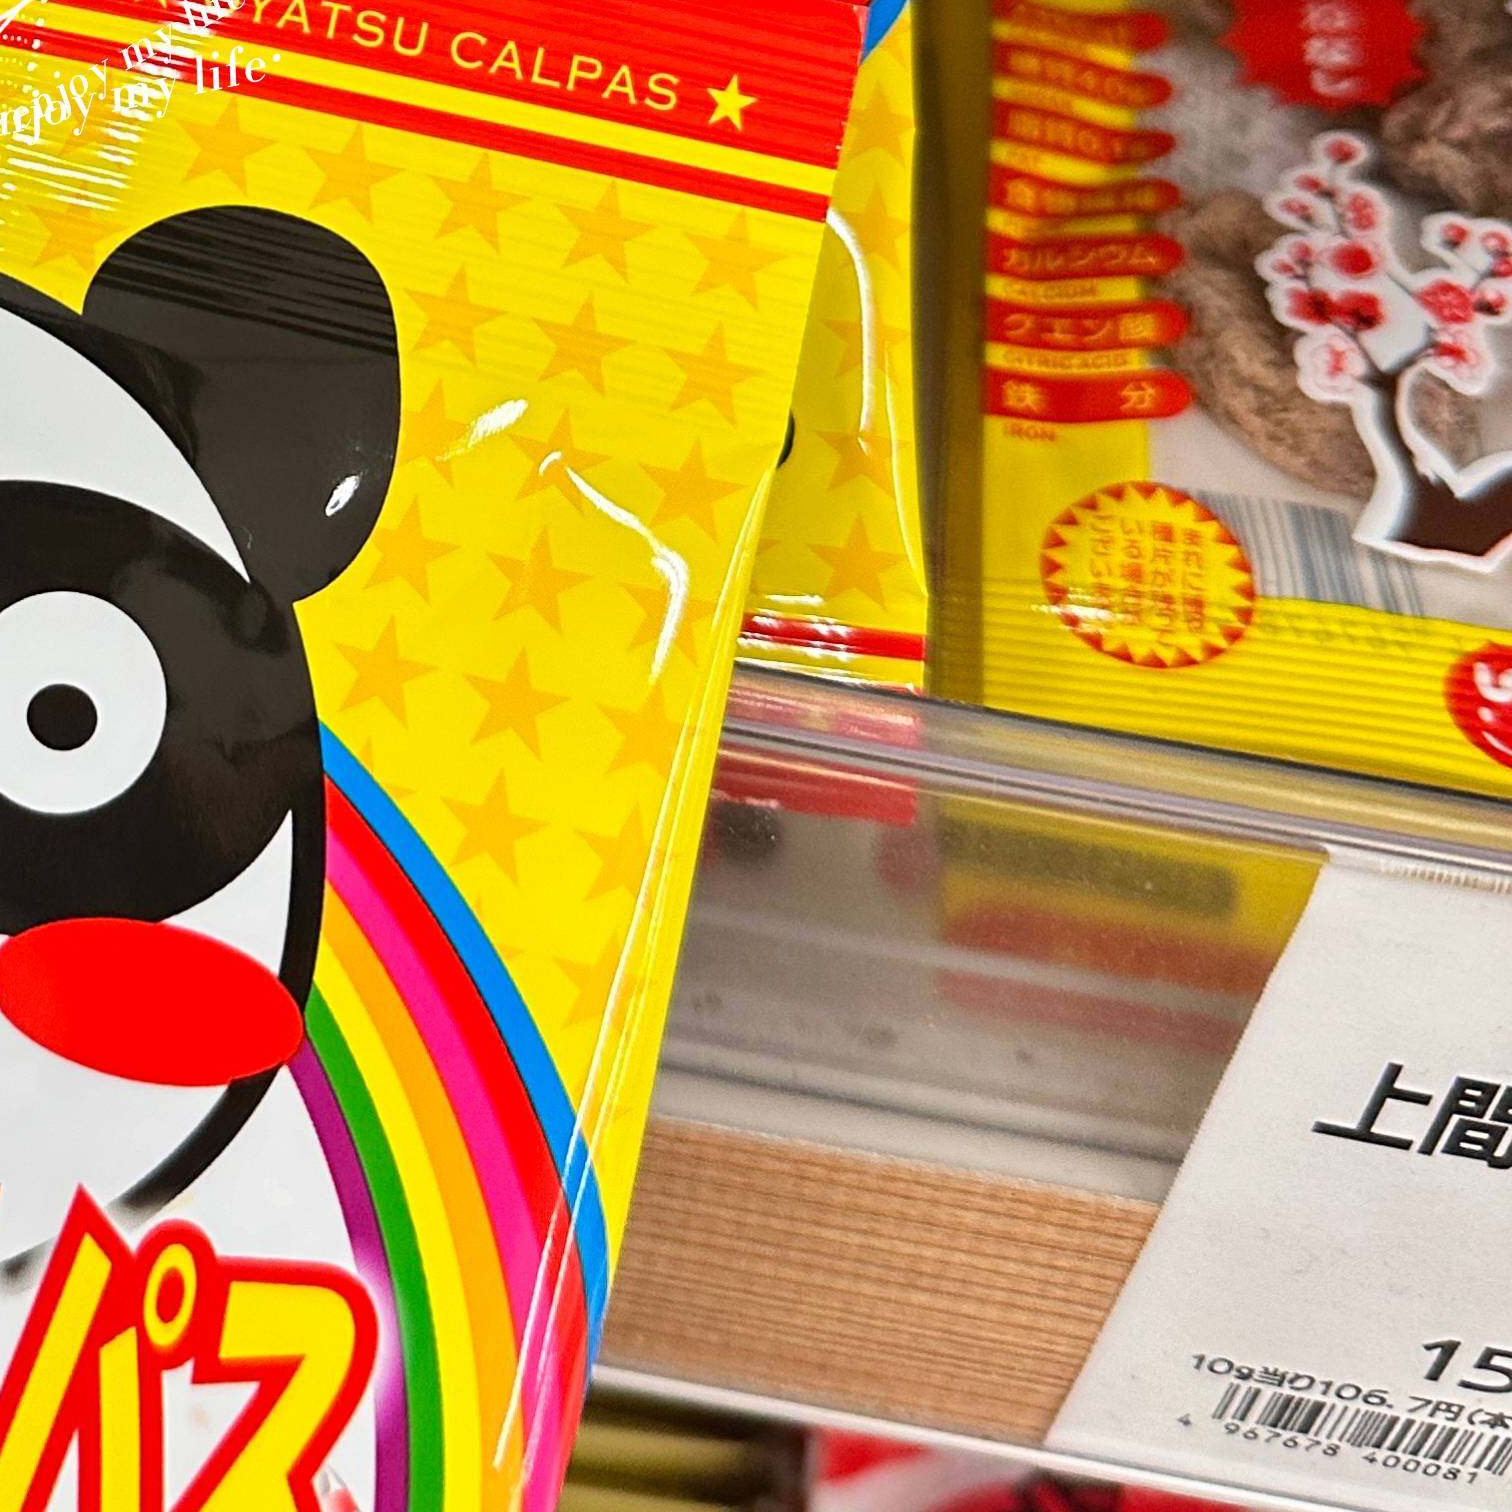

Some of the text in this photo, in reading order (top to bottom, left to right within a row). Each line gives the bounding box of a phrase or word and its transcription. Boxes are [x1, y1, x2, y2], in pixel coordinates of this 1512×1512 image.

[449, 30, 682, 110] CALPAS
[1223, 1422, 1341, 1458] 967678
[1360, 1450, 1480, 1486] 400081
